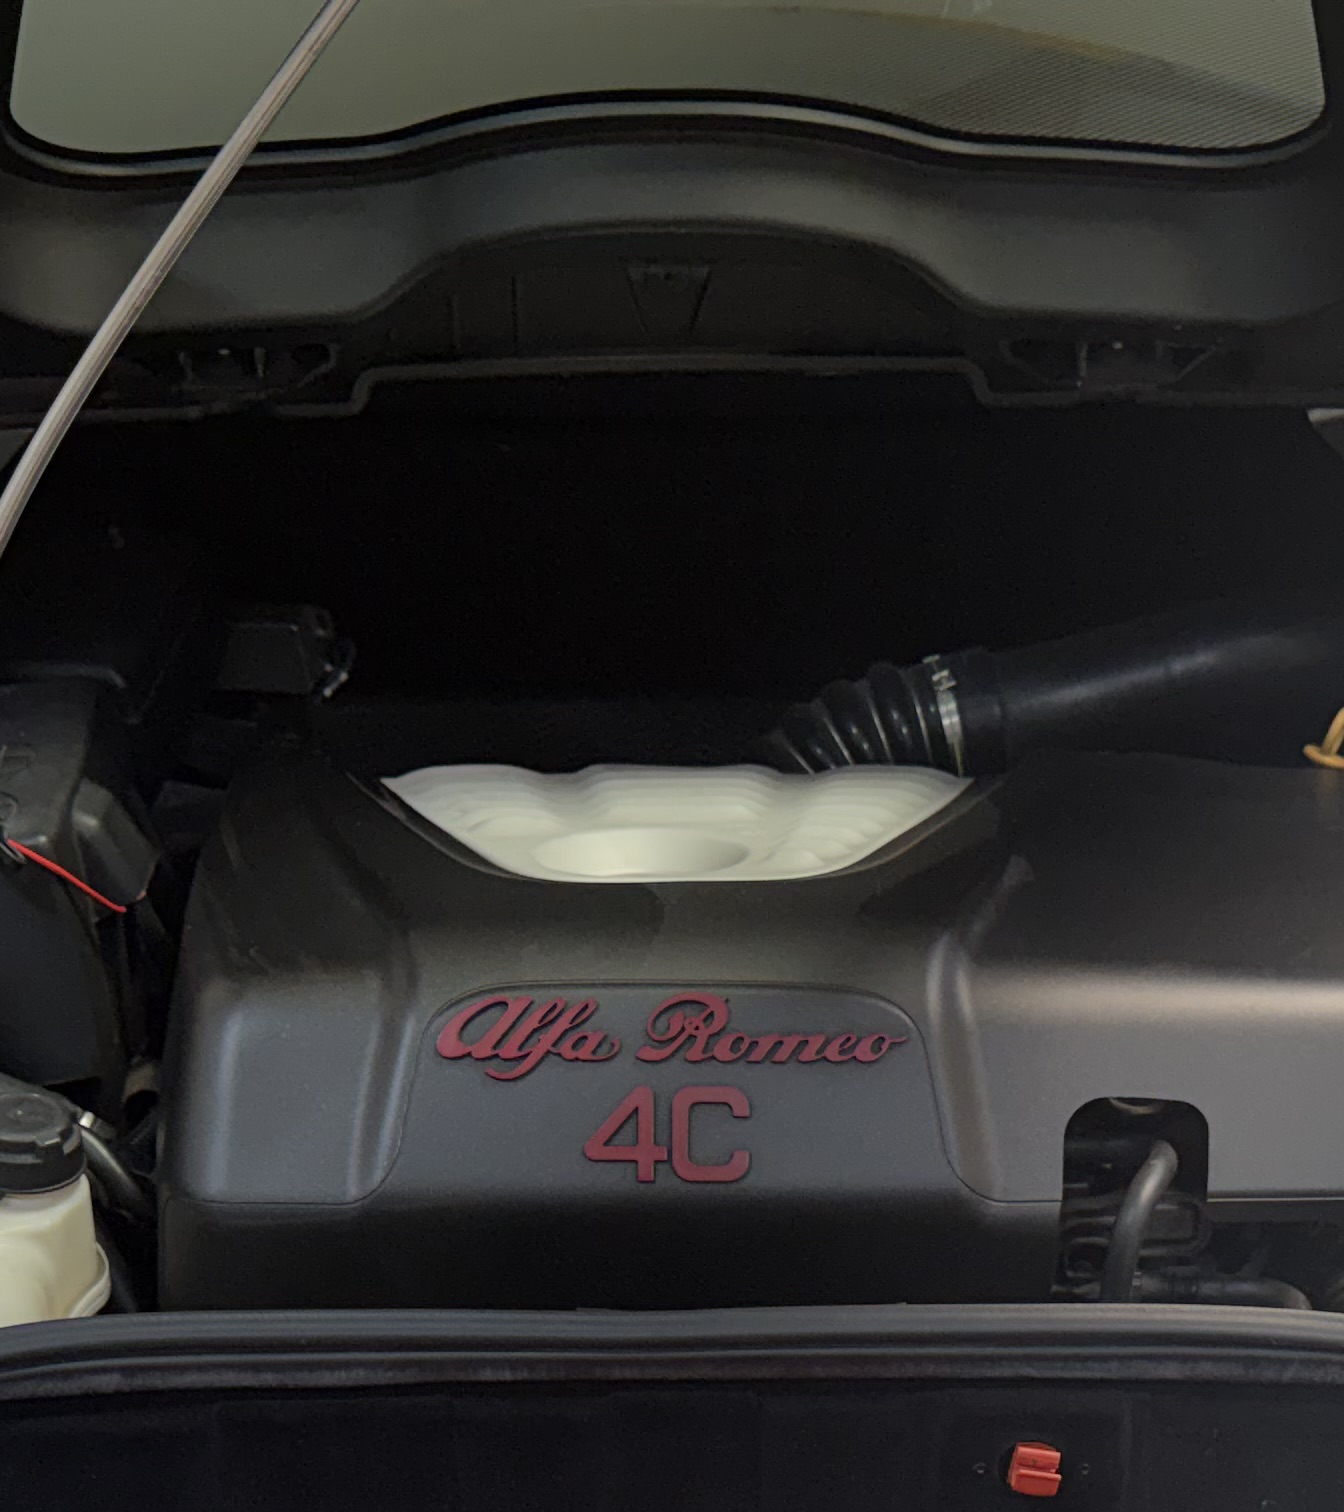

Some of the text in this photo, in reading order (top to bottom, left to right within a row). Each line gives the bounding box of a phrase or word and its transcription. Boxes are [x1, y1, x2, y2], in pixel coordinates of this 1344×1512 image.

[436, 991, 909, 1080] Alfa Romeo
[583, 1085, 750, 1183] 4C
